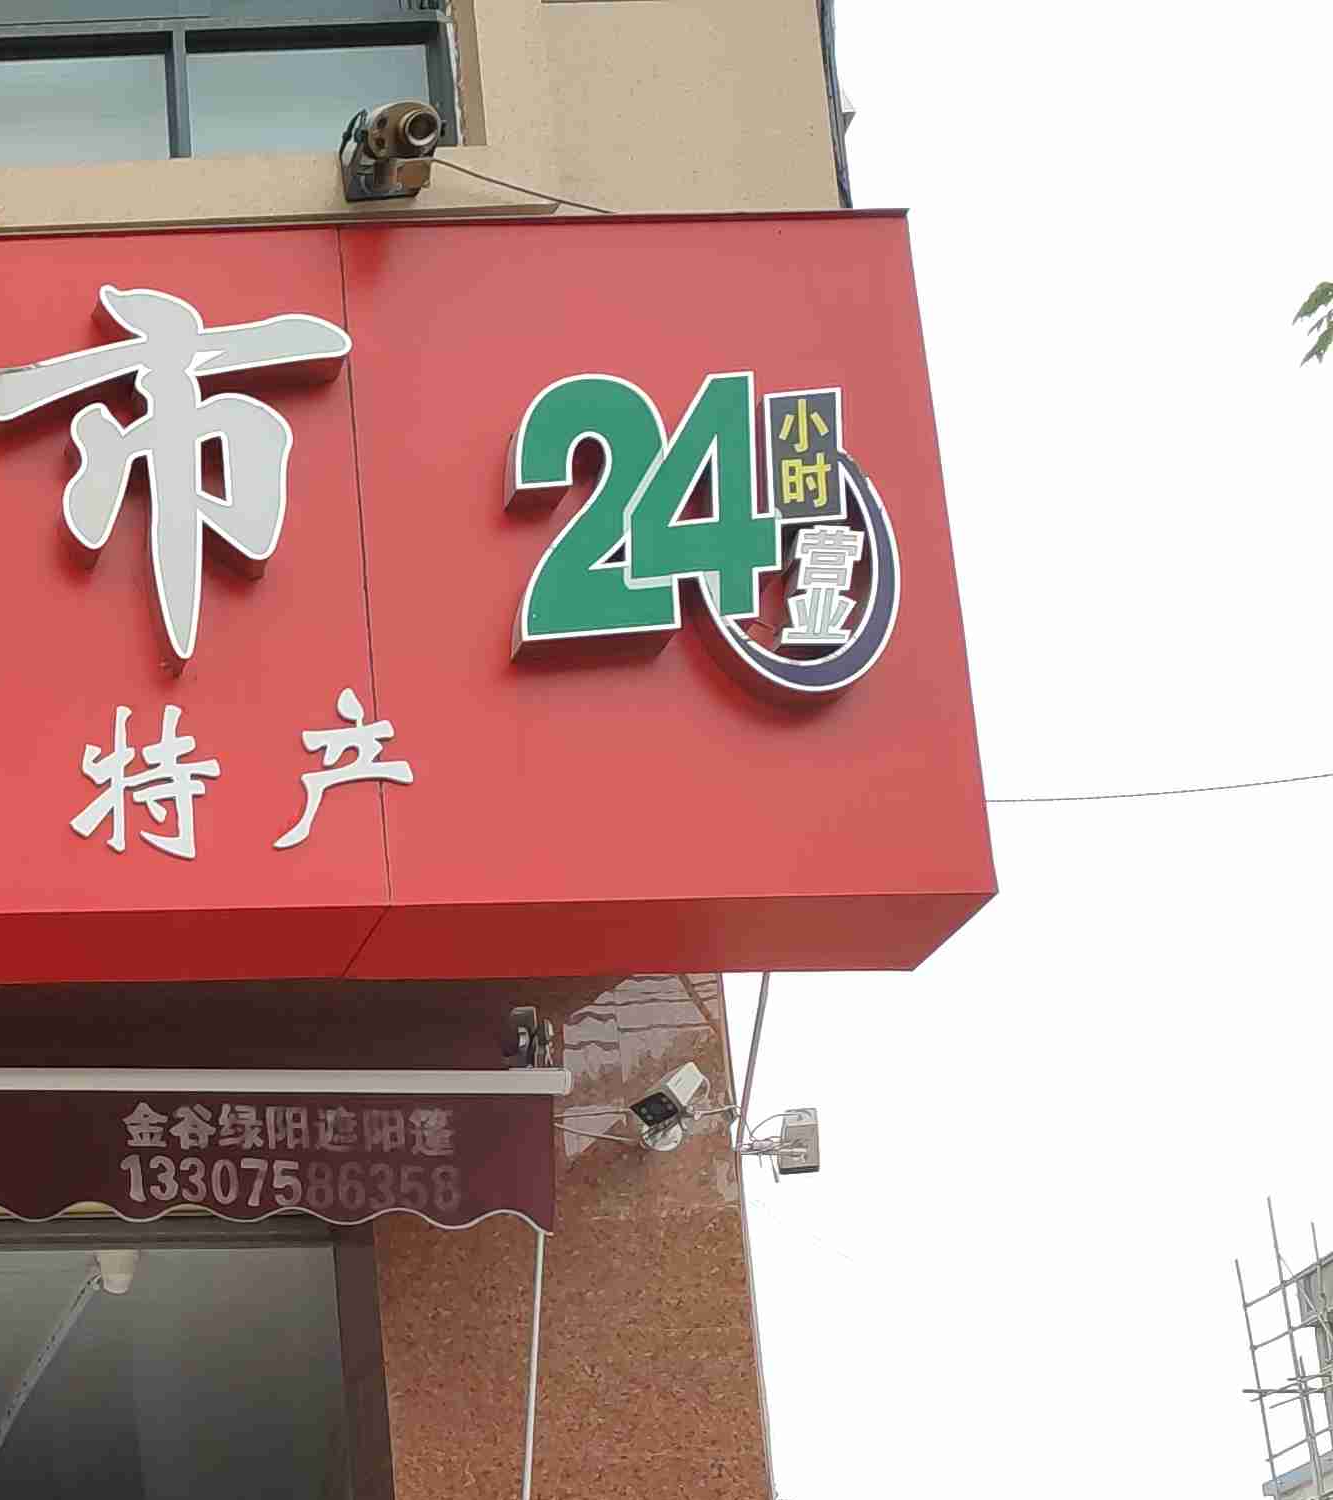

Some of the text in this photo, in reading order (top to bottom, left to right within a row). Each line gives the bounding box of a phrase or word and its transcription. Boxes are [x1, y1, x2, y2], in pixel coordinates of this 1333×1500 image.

[513, 370, 782, 650] 24
[778, 398, 832, 508] 小时
[781, 524, 864, 645] 营业
[71, 688, 415, 859] 特产
[120, 1154, 462, 1212] 13307586358
